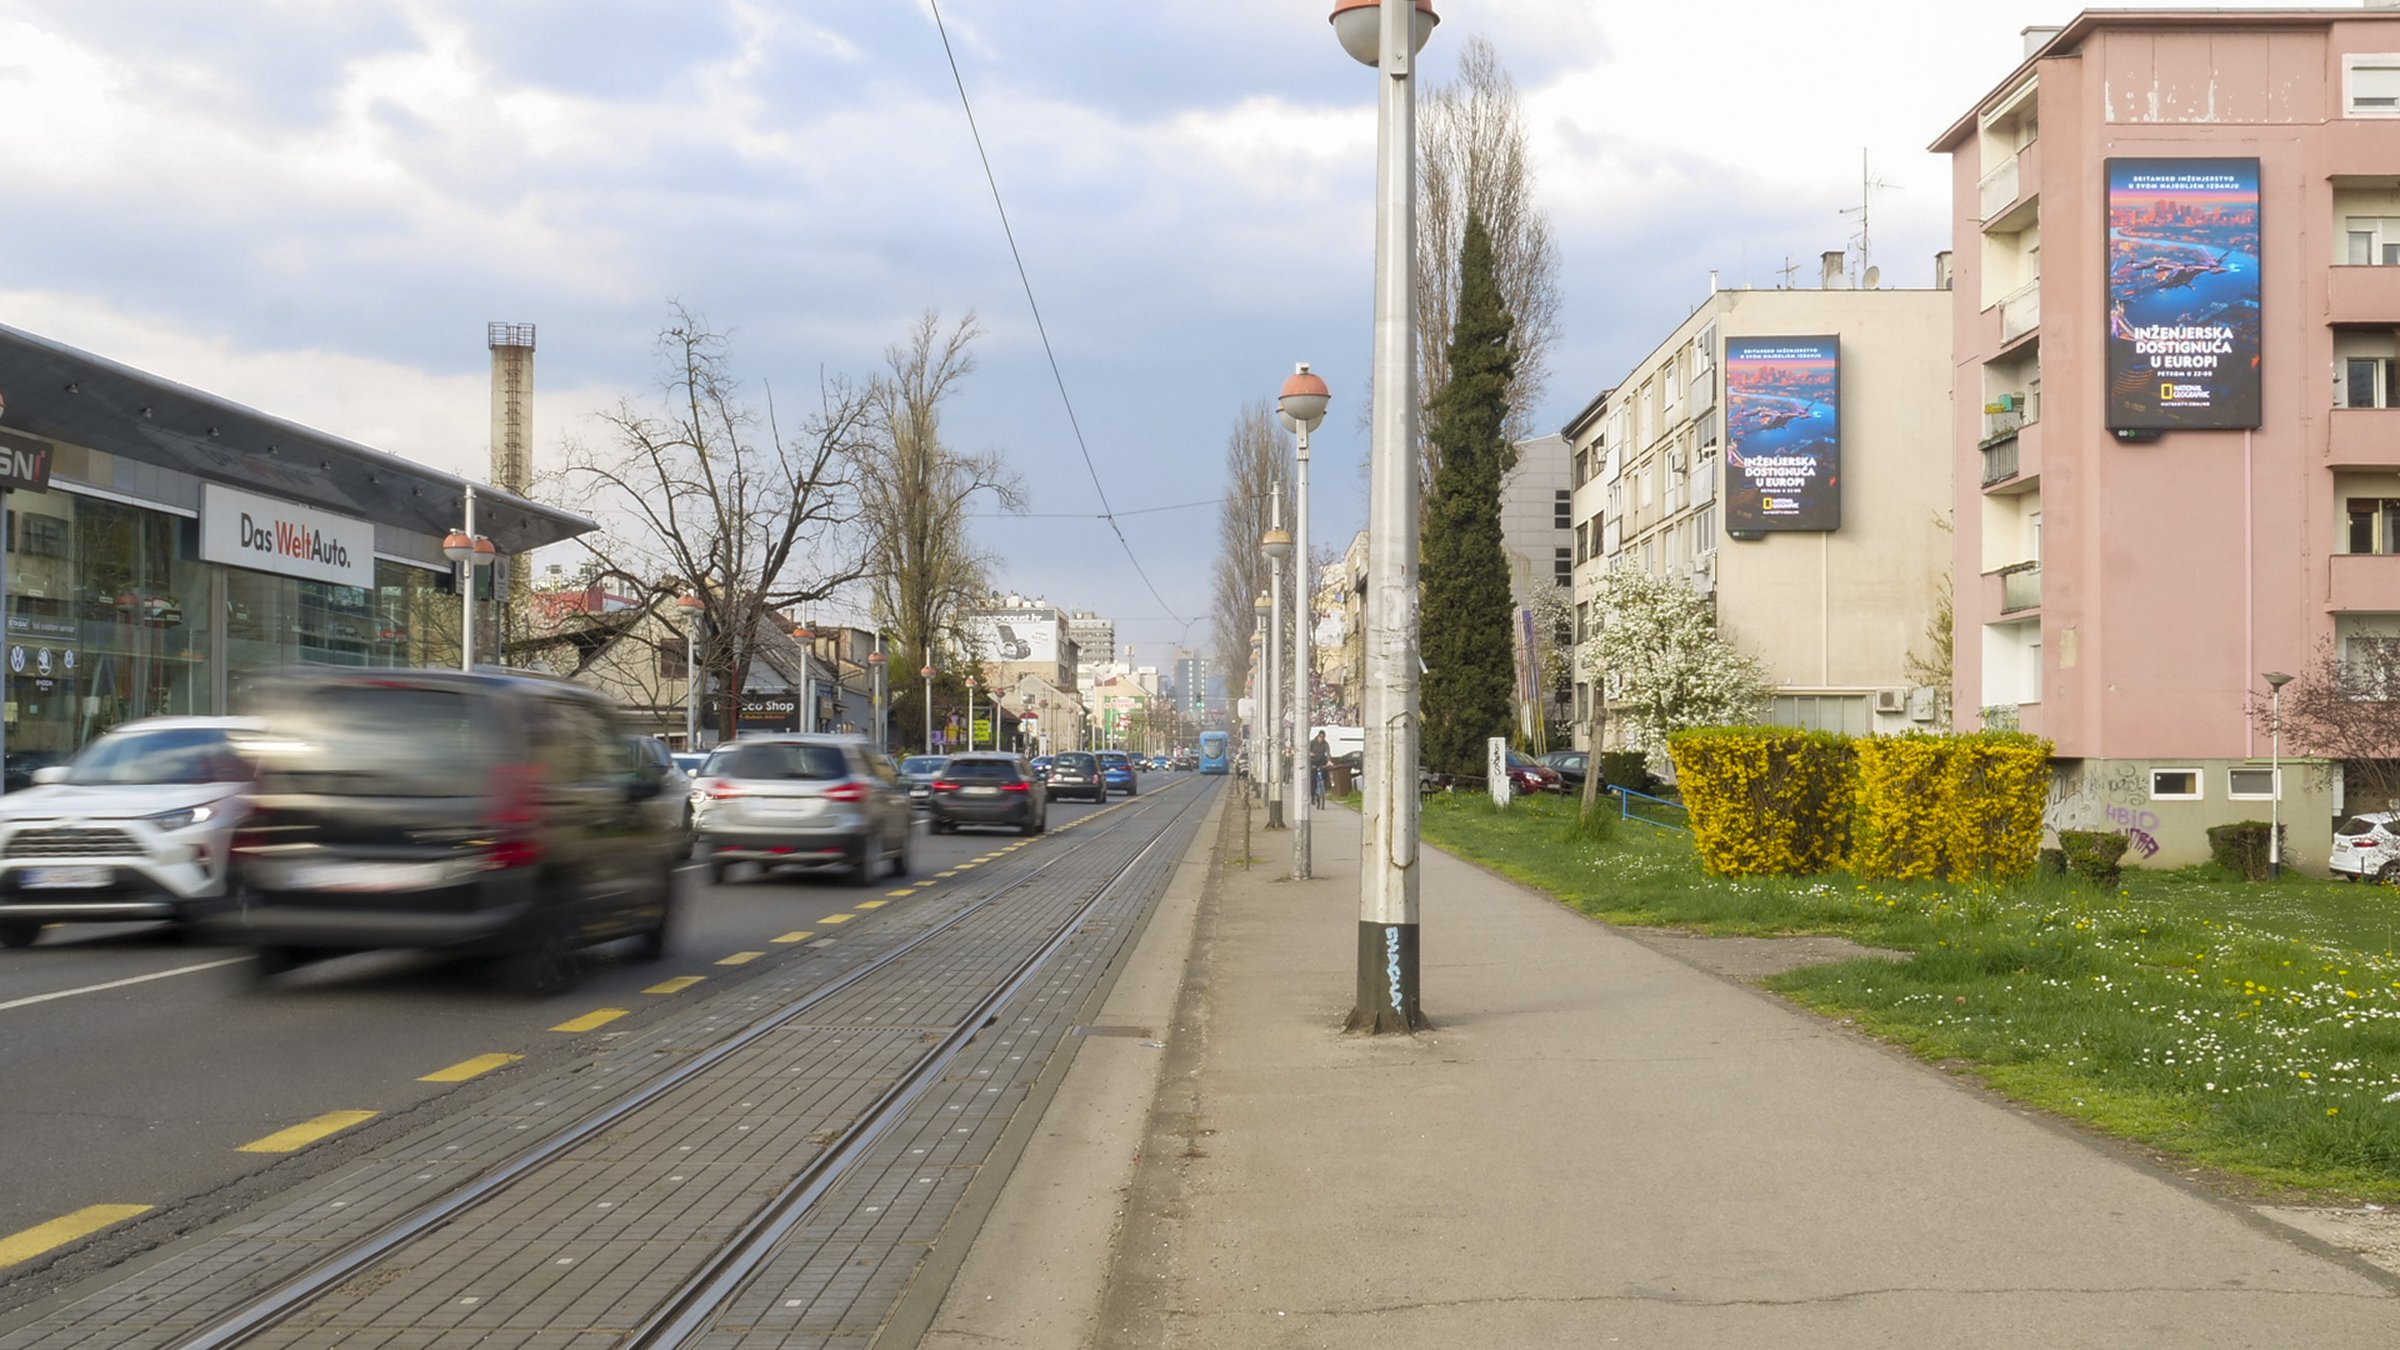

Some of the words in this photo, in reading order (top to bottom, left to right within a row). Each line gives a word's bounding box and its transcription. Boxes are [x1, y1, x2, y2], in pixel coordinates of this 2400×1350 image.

[2135, 324, 2234, 340] INŽENJERSKA
[2136, 339, 2232, 353] DOSTIGNUĆA
[2150, 355, 2161, 368] U
[2164, 355, 2217, 368] EUROPI
[1744, 455, 1817, 467] INŽENJERSKA
[1745, 466, 1816, 477] DOSTIGNUĆA
[1756, 477, 1764, 487] U
[1765, 477, 1805, 487] EUROPI
[241, 512, 273, 553] Das
[275, 520, 351, 569] WeltAuto.
[765, 701, 794, 713] Shop
